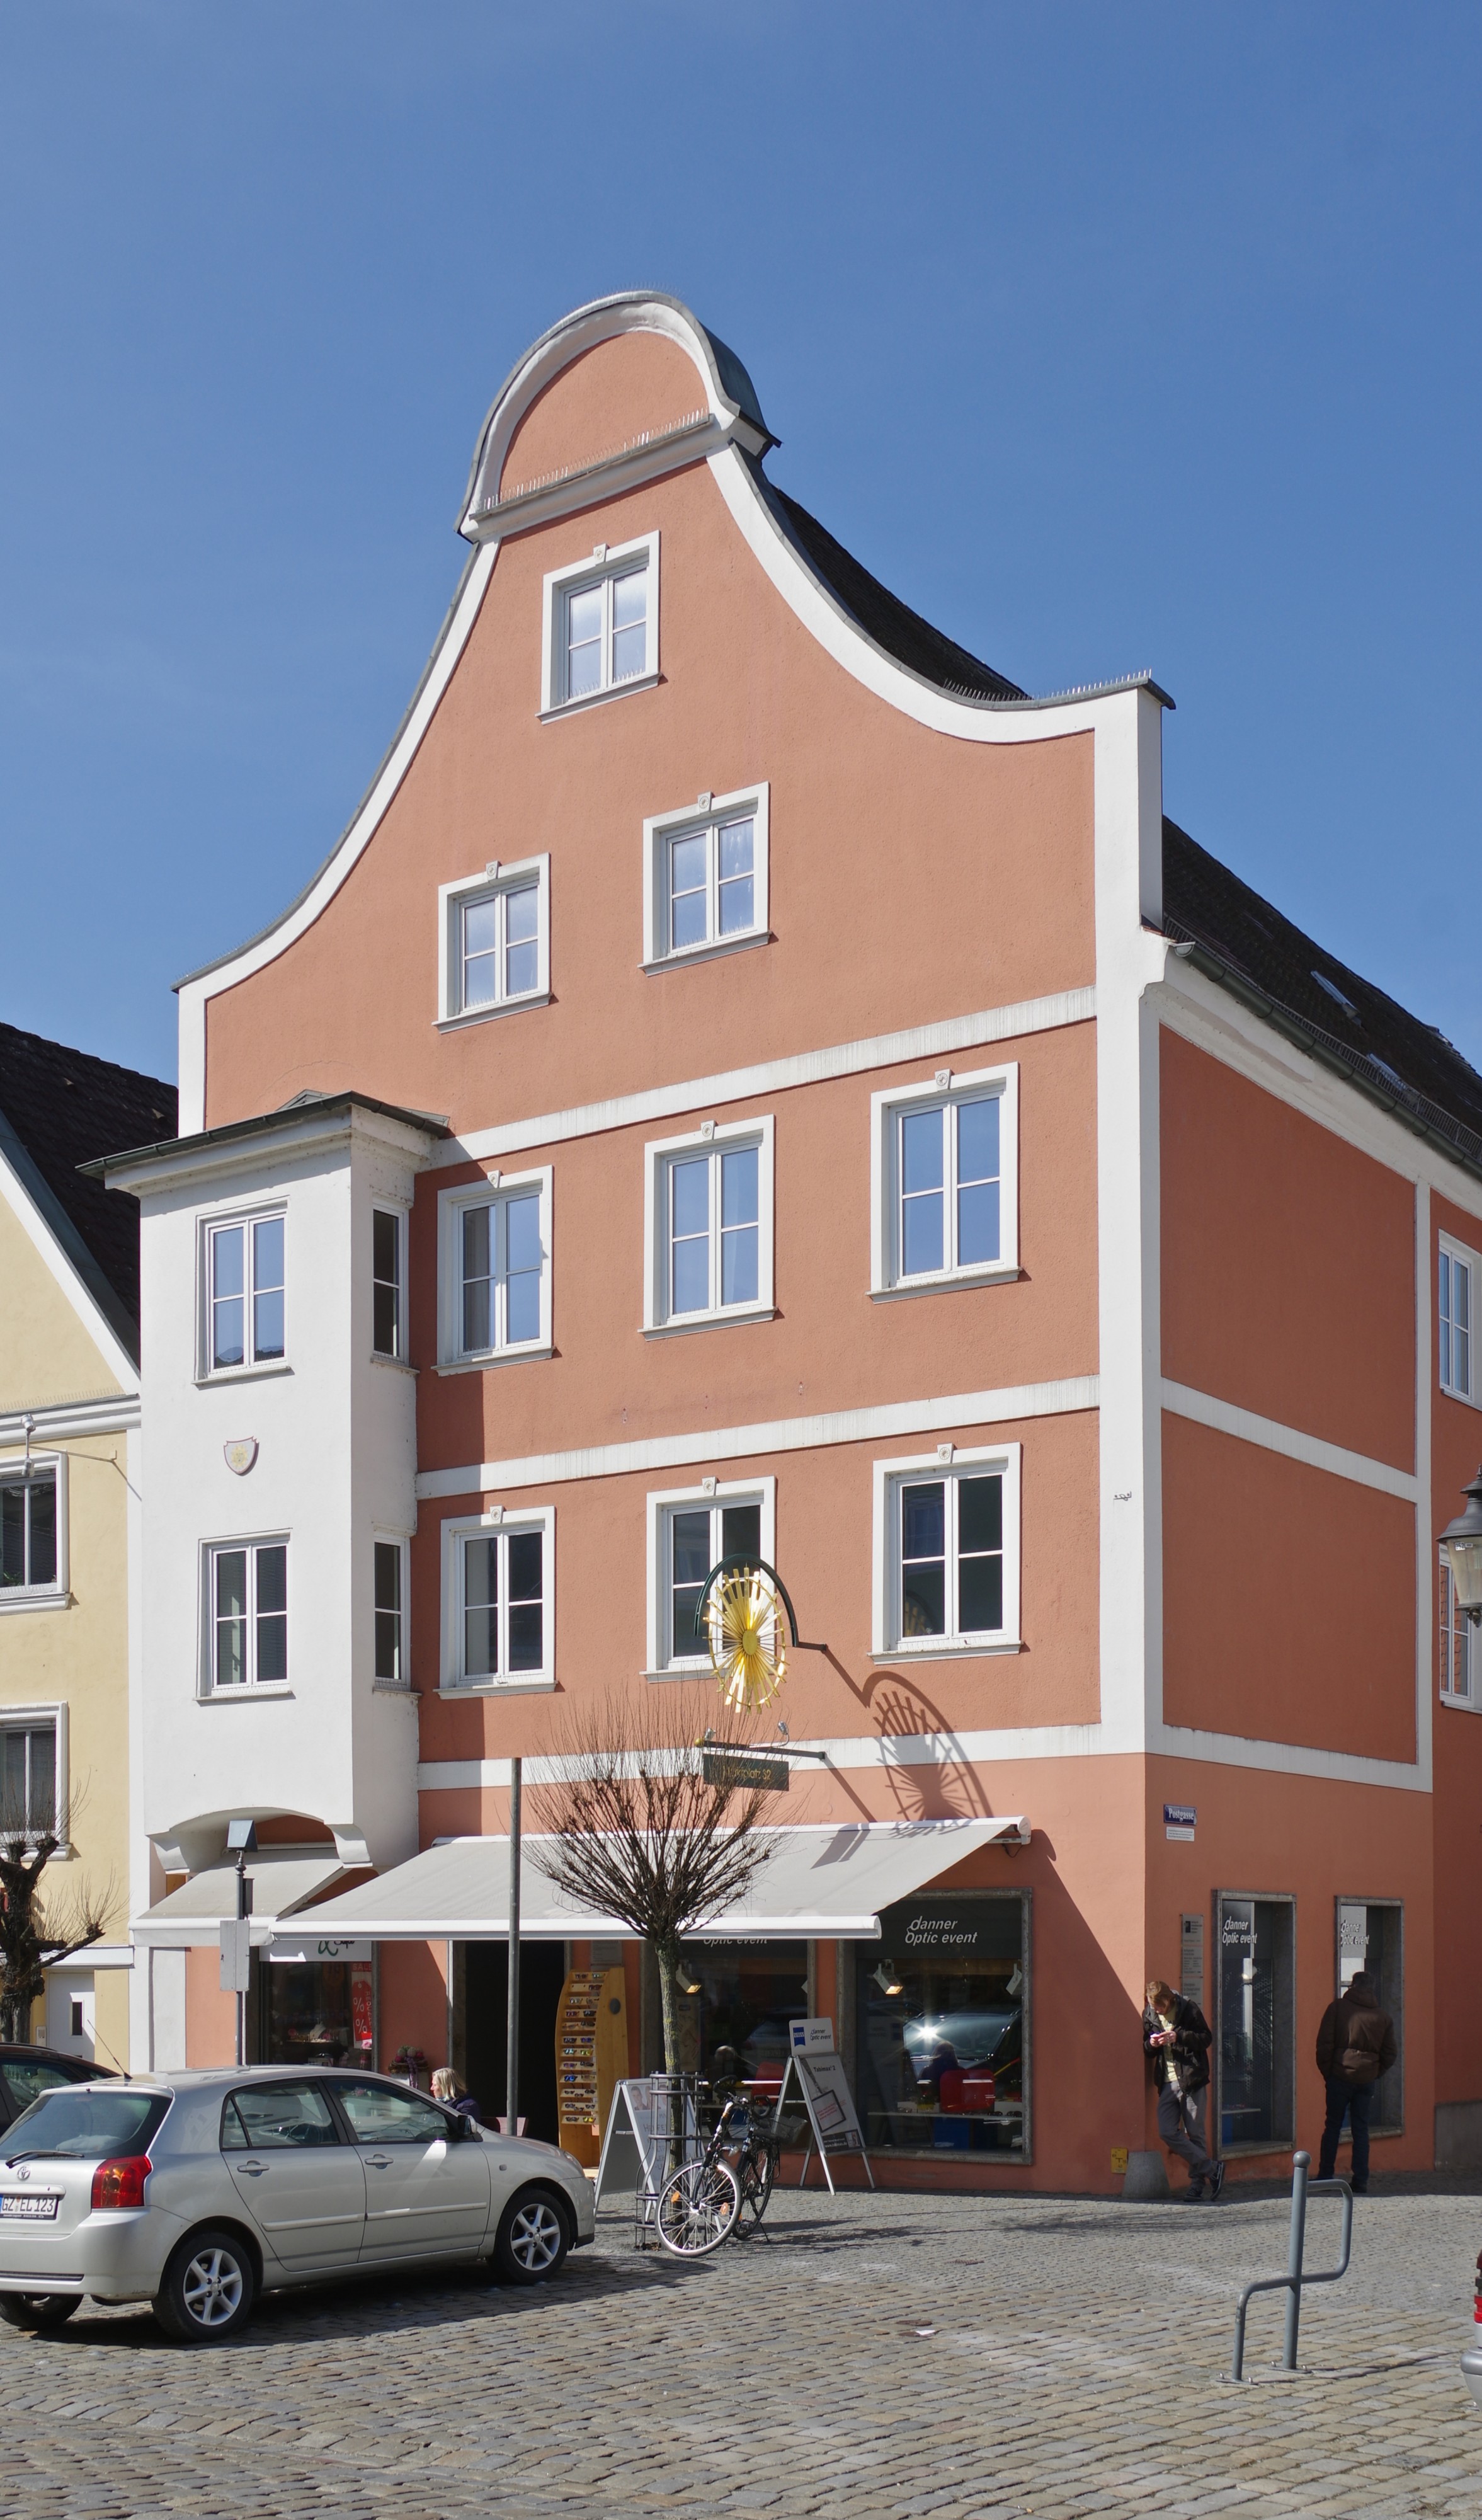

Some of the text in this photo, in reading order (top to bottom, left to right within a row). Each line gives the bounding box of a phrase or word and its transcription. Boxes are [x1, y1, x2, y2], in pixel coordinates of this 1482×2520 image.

[1168, 1807, 1194, 1822] Postgasse
[909, 1916, 958, 1930] danner
[1224, 1916, 1248, 1930] danner
[905, 1932, 978, 1946] Optic event
[1223, 1932, 1257, 1946] Optic event
[1354, 1934, 1369, 1945] event
[2, 2197, 54, 2213] GZ EL 123
